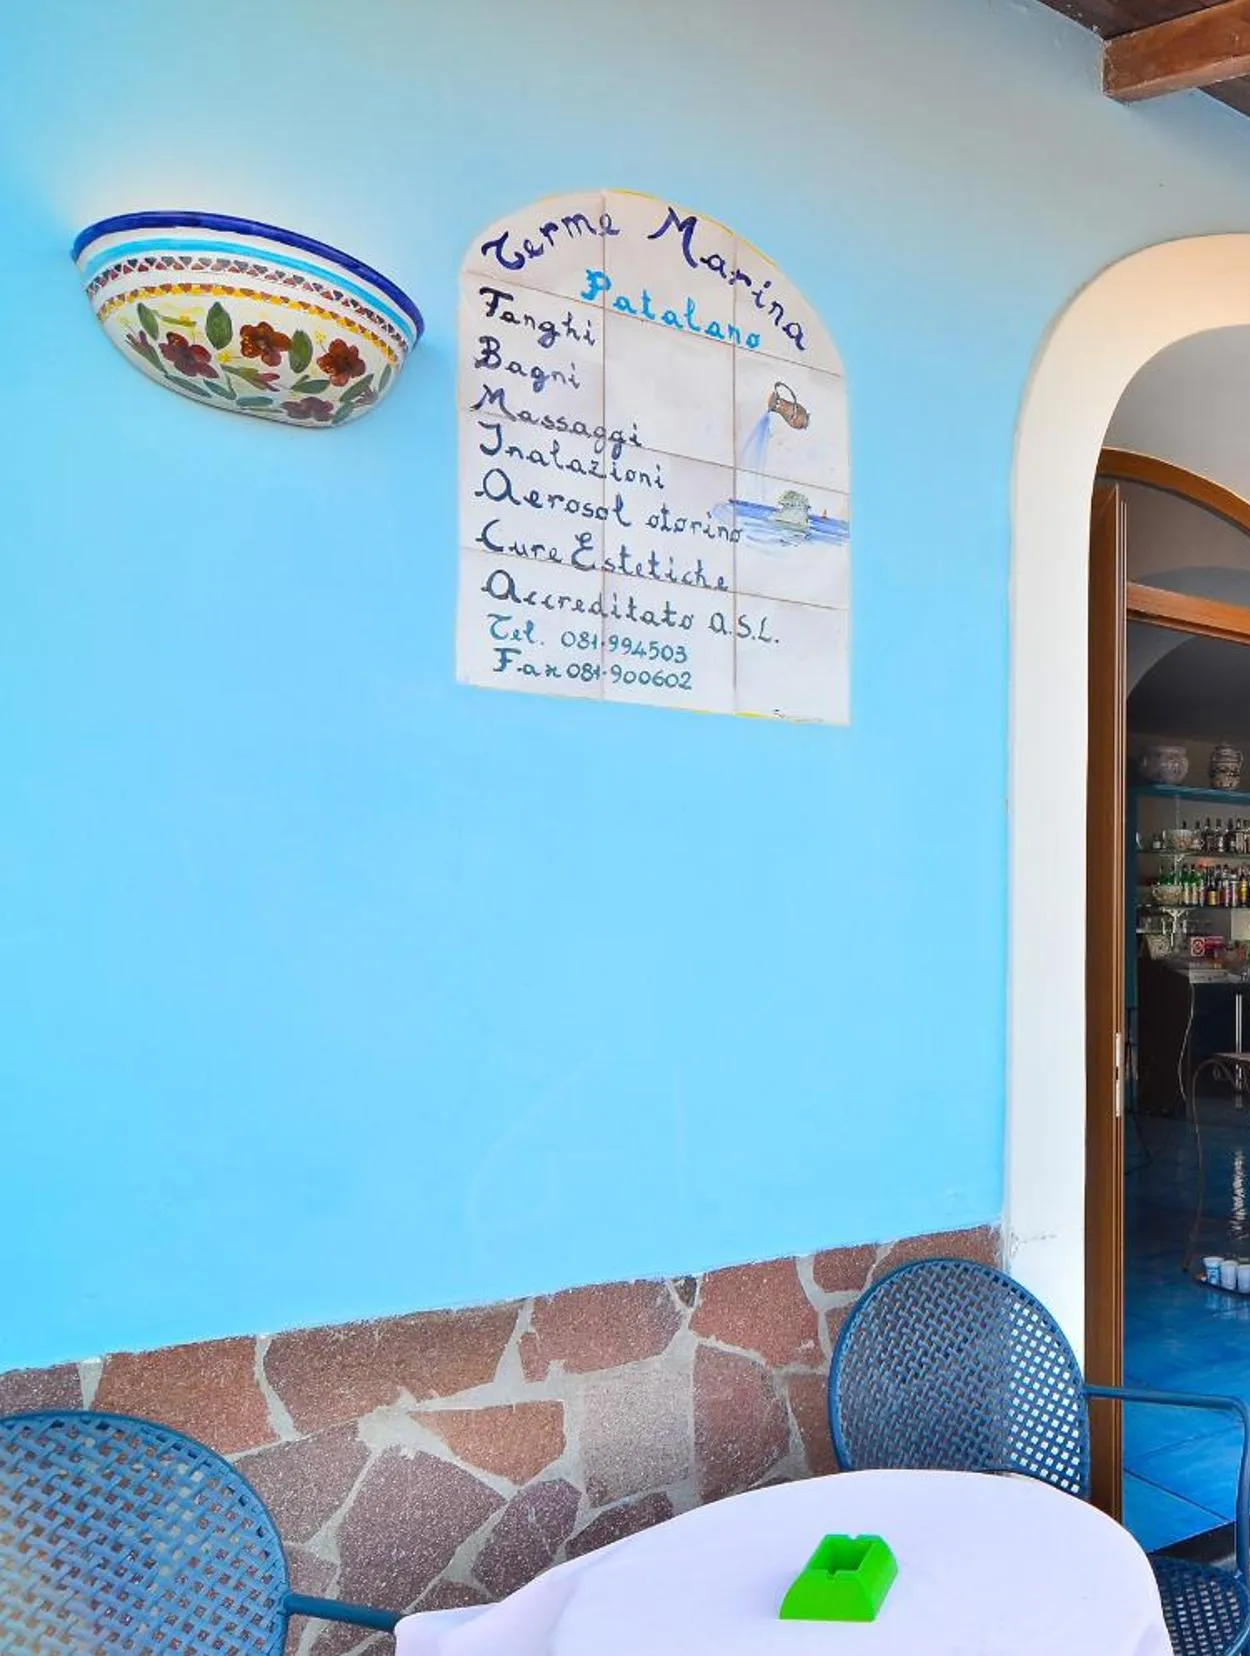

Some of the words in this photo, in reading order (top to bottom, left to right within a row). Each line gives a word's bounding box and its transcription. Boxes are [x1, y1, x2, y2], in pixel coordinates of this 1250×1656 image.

[481, 212, 620, 271] Terme
[647, 206, 806, 351] Marina
[580, 268, 761, 349] Patalano
[479, 286, 596, 348] Fanghi
[474, 335, 580, 393] Bagni
[469, 384, 642, 460] Massaggi
[479, 421, 664, 490] Inalazioni
[474, 468, 632, 528] Aerosol
[645, 503, 744, 543] otorino
[475, 519, 563, 564] Cure
[570, 532, 729, 591] Estetiche
[481, 569, 693, 630] Accreditato
[493, 647, 566, 677] Fax
